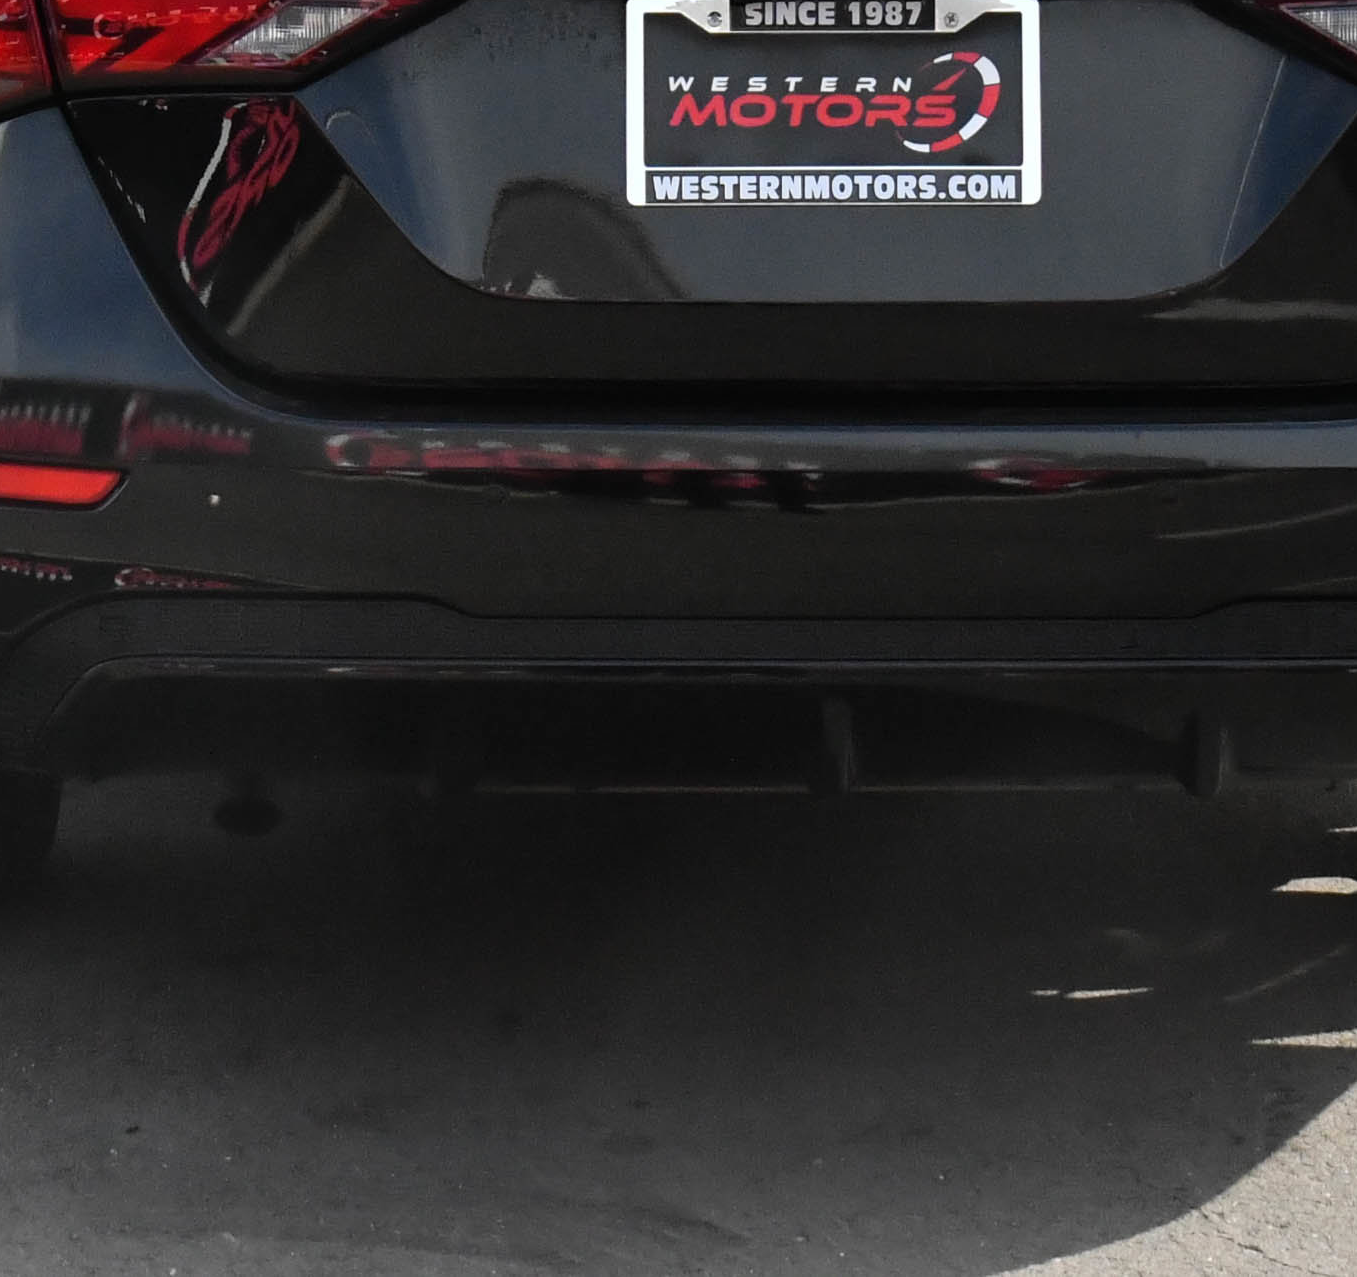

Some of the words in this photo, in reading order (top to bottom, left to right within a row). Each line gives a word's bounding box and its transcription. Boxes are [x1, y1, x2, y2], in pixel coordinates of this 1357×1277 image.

[744, 1, 836, 26] SINCE
[847, 1, 922, 26] 1987
[668, 76, 912, 93] WESTERN
[669, 94, 957, 127] MOTORS
[653, 174, 1017, 201] WESTERNMOTORS.COM
